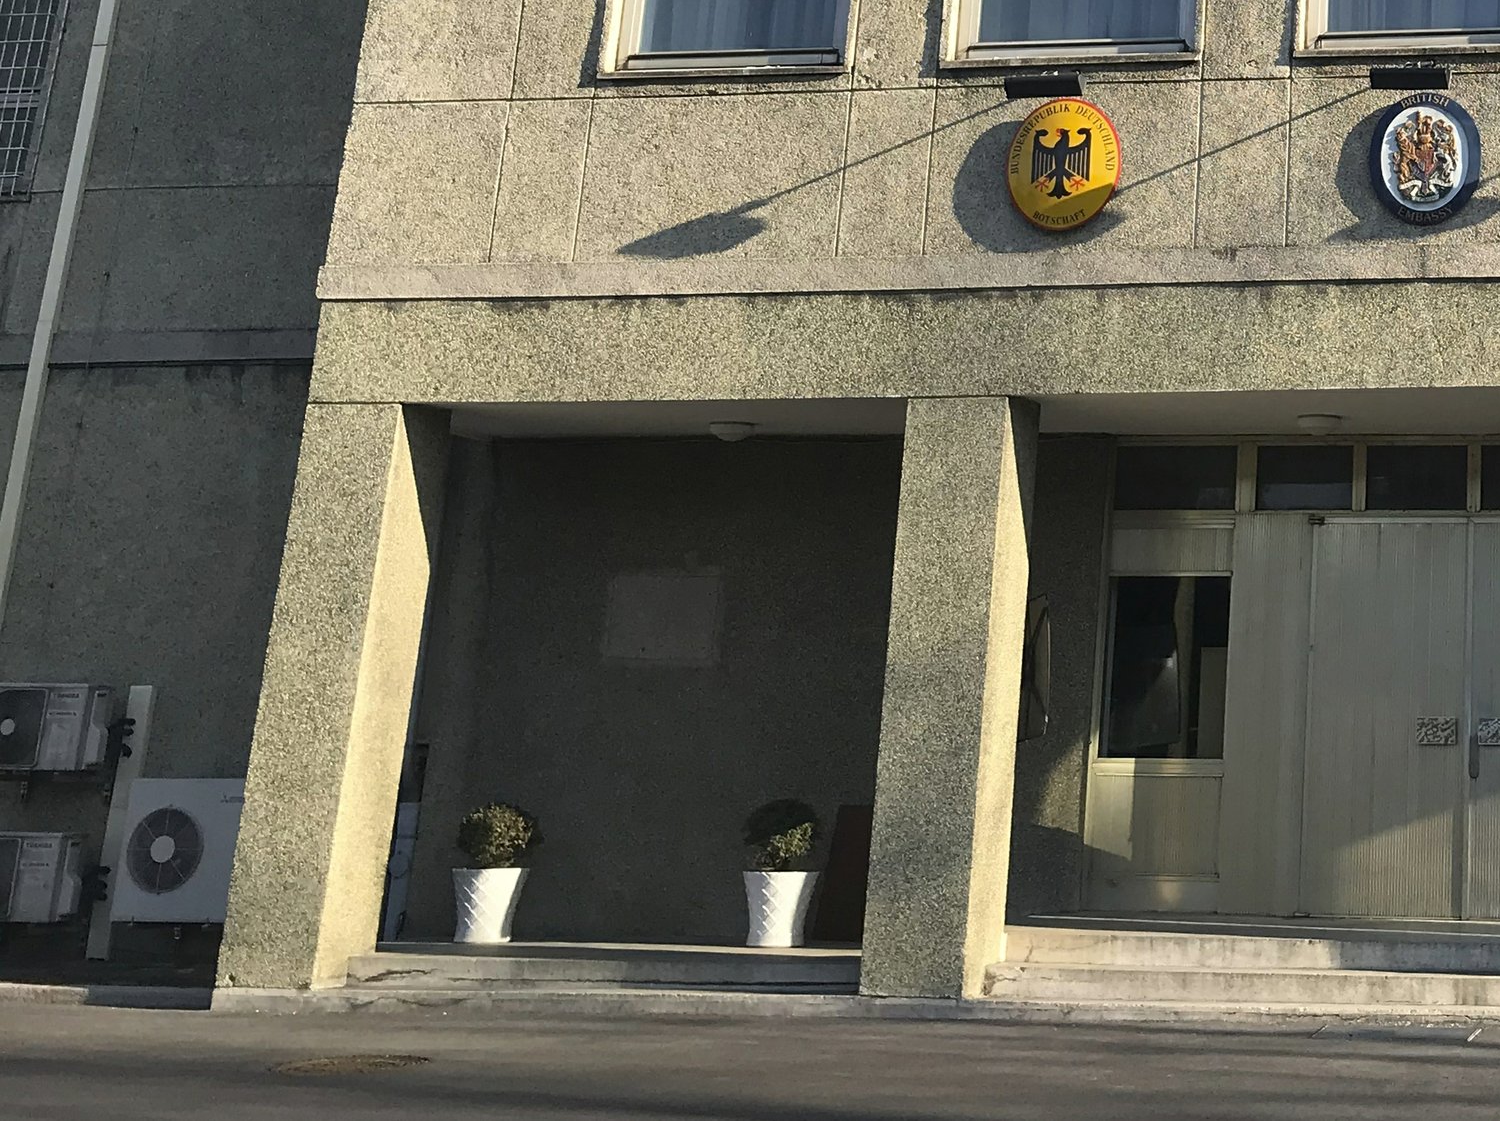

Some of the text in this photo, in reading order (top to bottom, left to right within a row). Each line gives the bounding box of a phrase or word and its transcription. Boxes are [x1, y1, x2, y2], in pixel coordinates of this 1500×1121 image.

[1400, 94, 1450, 108] BRITISH
[1010, 103, 1116, 175] BUNDESREPUBLIK DEUTSCHLAND
[1032, 208, 1087, 225] BOTSCHAFT
[1397, 207, 1454, 223] EMBASSY
